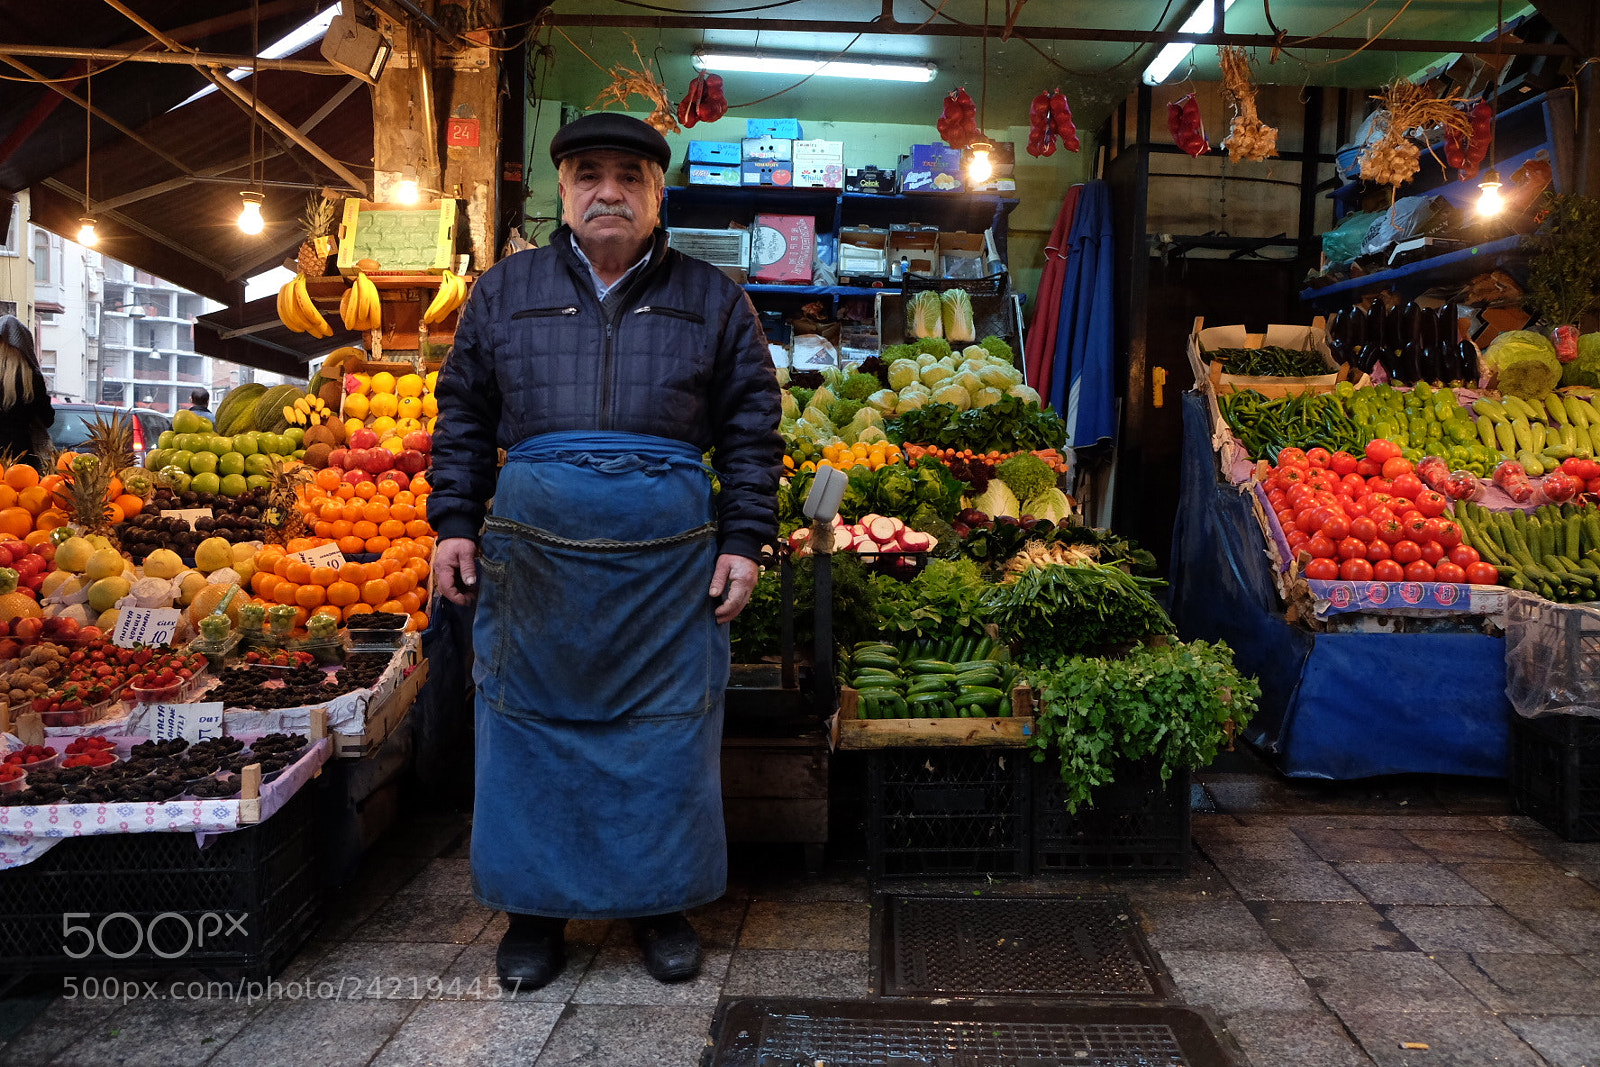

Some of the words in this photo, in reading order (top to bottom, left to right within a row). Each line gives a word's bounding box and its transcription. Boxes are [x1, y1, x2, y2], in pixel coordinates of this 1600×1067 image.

[453, 125, 469, 139] 24
[120, 610, 134, 641] ANTALYA
[137, 610, 151, 642] AROMALI
[148, 630, 168, 644] 10
